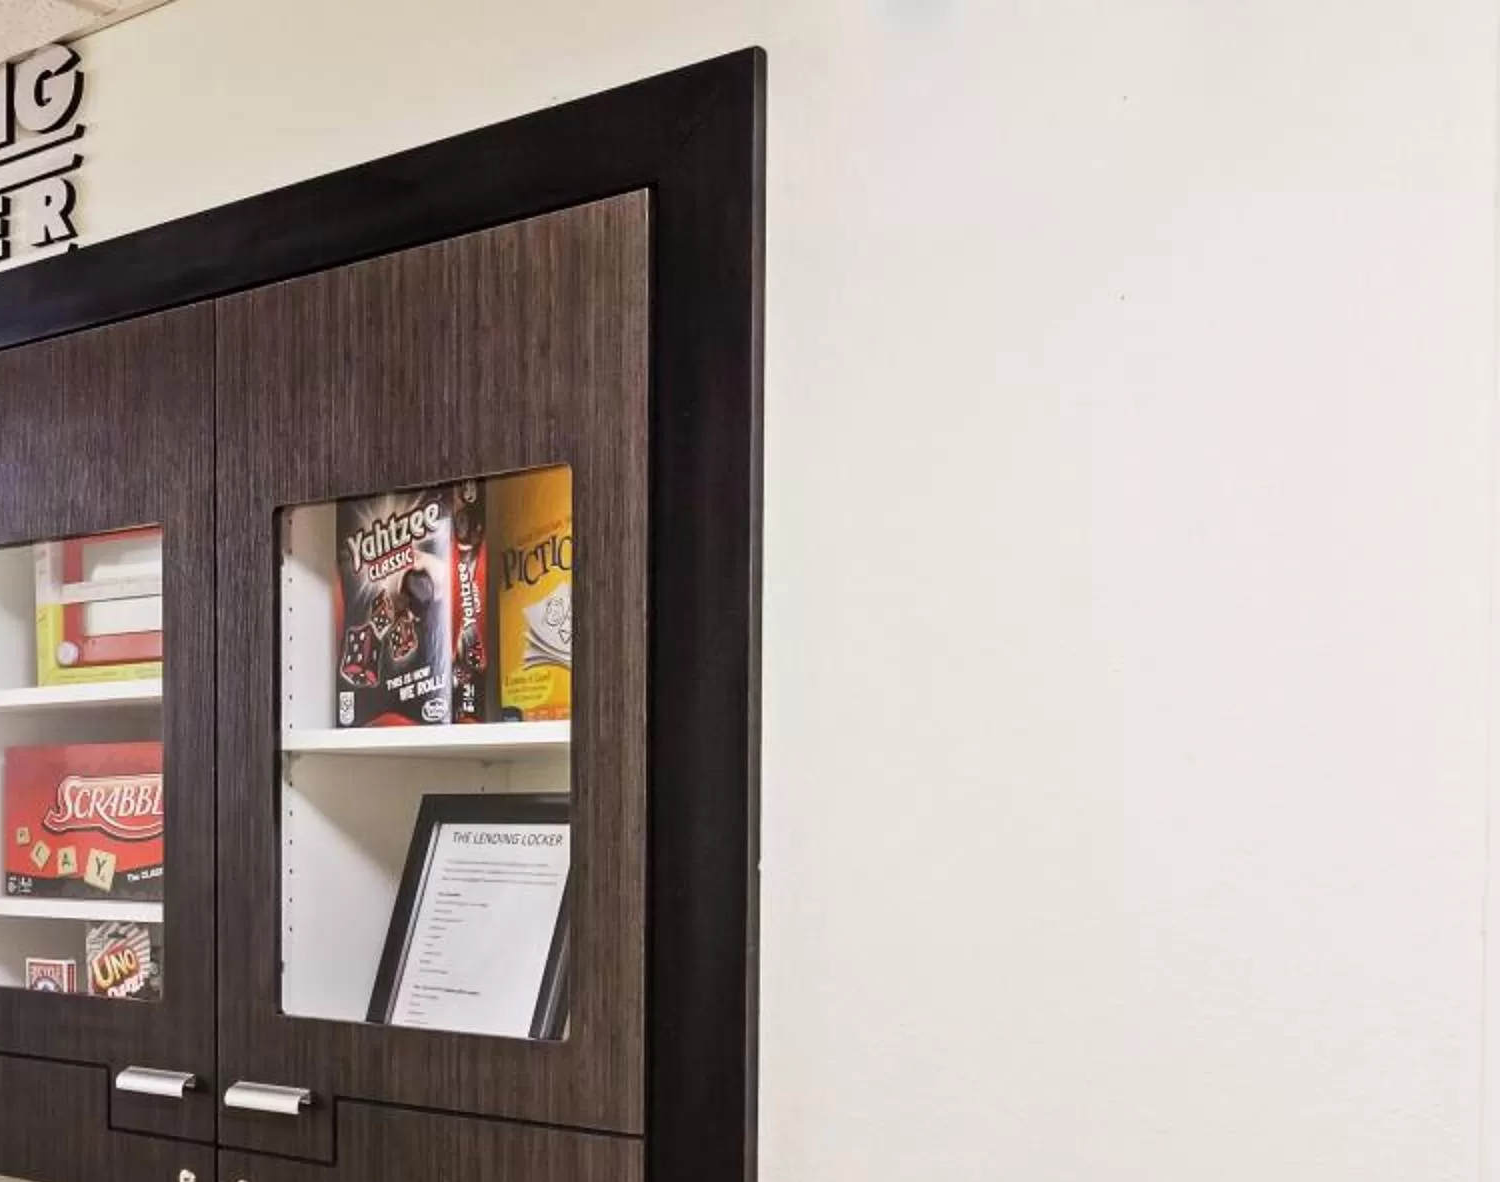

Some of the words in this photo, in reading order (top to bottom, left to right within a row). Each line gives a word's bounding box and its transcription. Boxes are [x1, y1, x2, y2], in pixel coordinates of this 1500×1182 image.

[347, 502, 440, 572] Yahtzee
[368, 547, 413, 581] CLASSIC
[456, 562, 477, 628] Yahtzee
[452, 831, 473, 844] THE
[473, 831, 521, 846] LENDING
[521, 832, 564, 847] LOCKER
[91, 949, 137, 990] UNO
